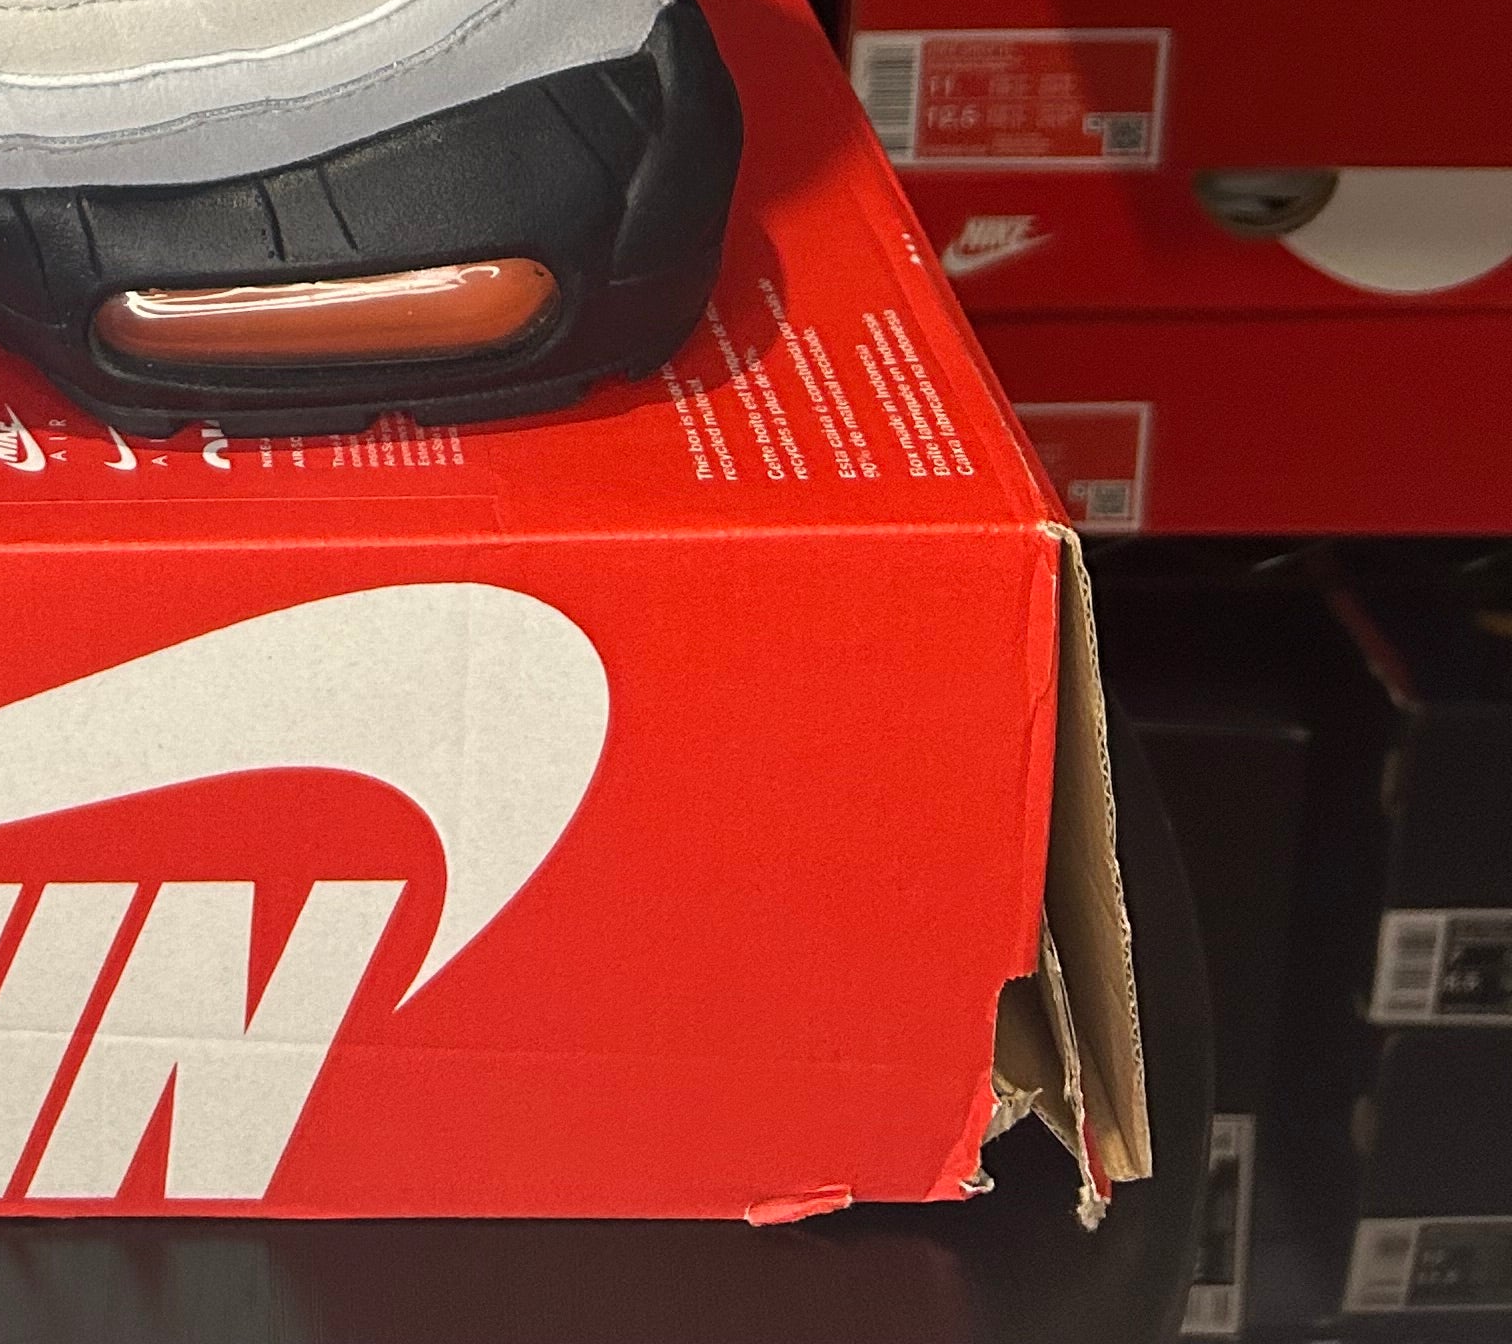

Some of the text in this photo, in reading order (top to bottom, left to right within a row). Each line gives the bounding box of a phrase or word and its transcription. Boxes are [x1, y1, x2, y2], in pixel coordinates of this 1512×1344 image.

[777, 320, 798, 341] por
[754, 373, 771, 389] de
[888, 366, 905, 383] en
[910, 362, 928, 381] na
[737, 389, 758, 411] est
[762, 389, 786, 415] plus
[823, 380, 859, 430] material
[855, 343, 928, 478] Box made in Indonesia
[667, 379, 714, 481] This box is made
[819, 414, 843, 450] caixa
[848, 431, 867, 448] de
[704, 427, 738, 482] recycled
[760, 445, 785, 481] Cette
[834, 449, 857, 479] Esta
[856, 449, 882, 479] 90%
[947, 438, 976, 477] Caixa
